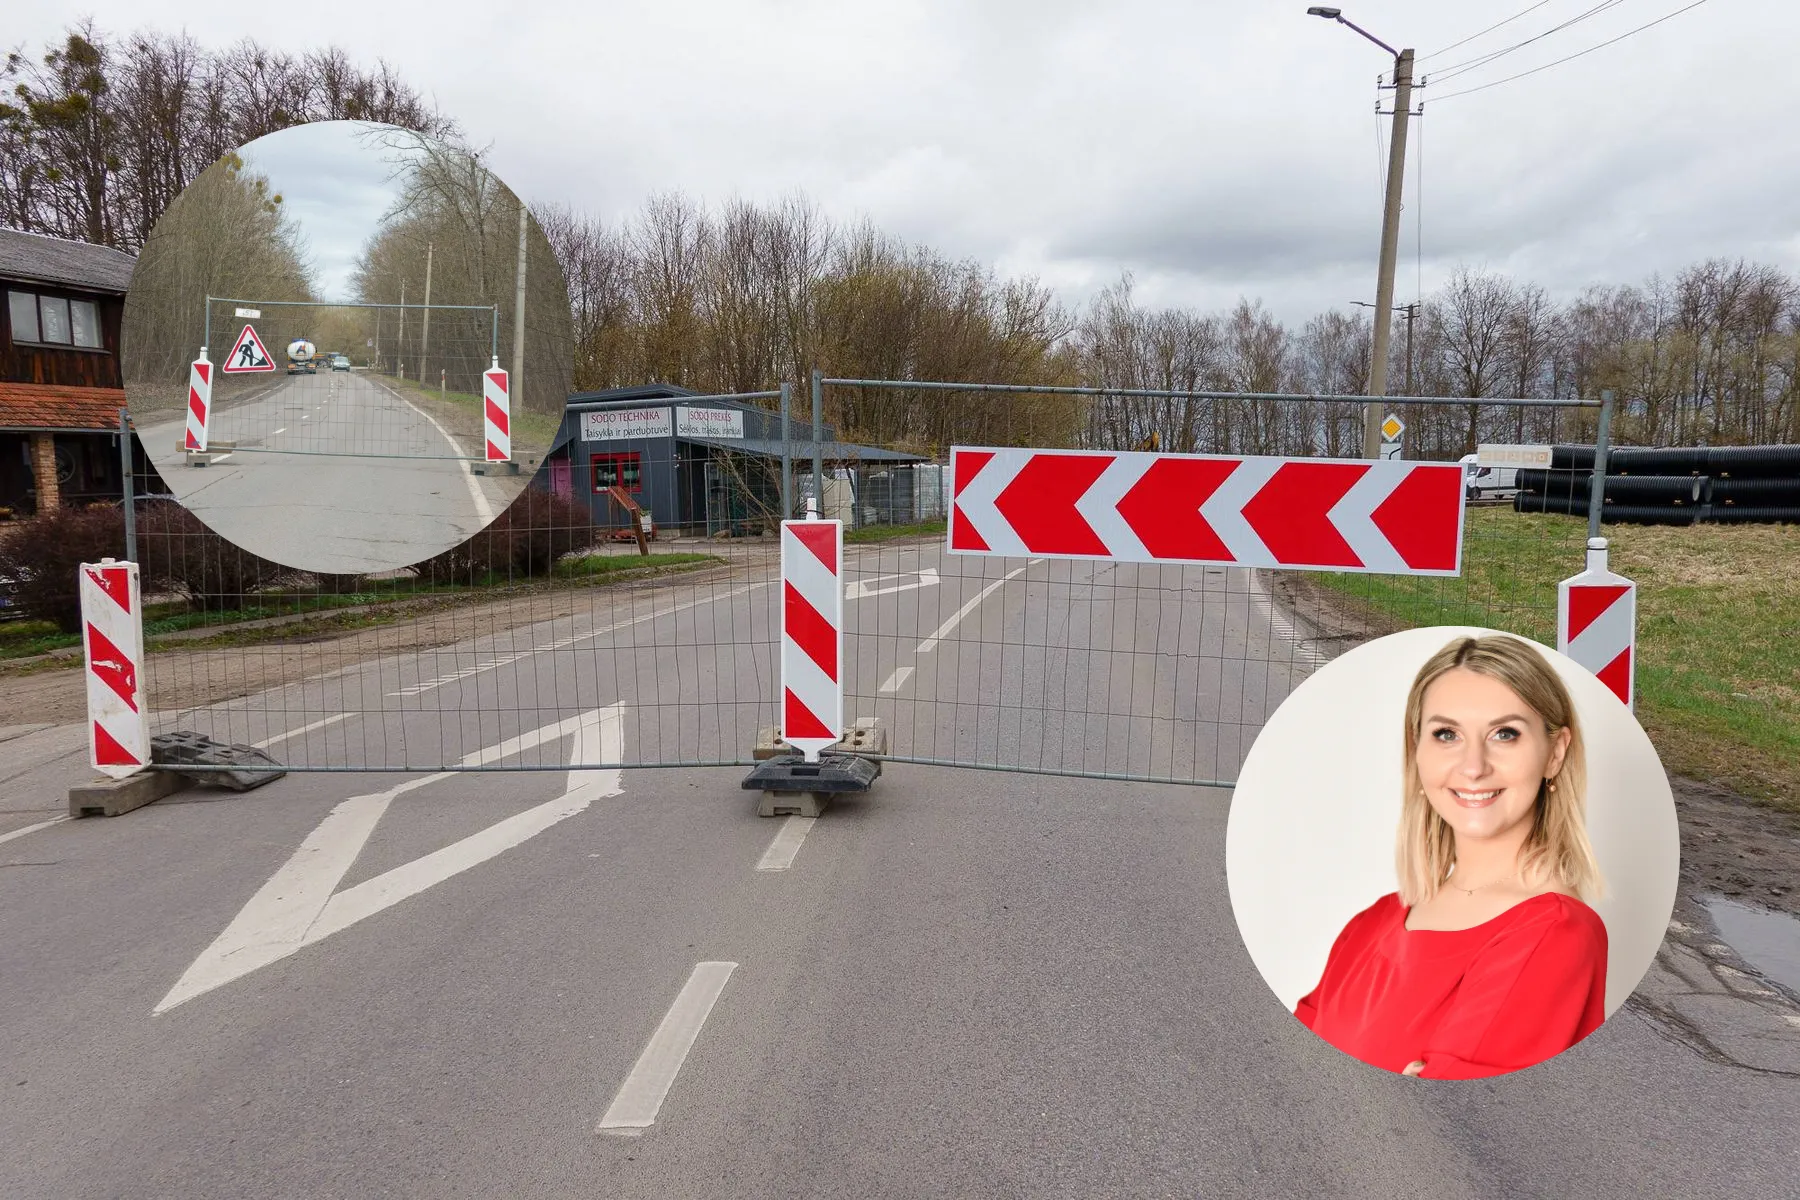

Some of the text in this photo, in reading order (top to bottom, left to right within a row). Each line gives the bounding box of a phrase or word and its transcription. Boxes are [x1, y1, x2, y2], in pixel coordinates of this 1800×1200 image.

[591, 411, 660, 424] SODO TECHNIKA
[690, 411, 708, 420] SODO
[585, 425, 669, 439] Taisykla ir parduotuvė
